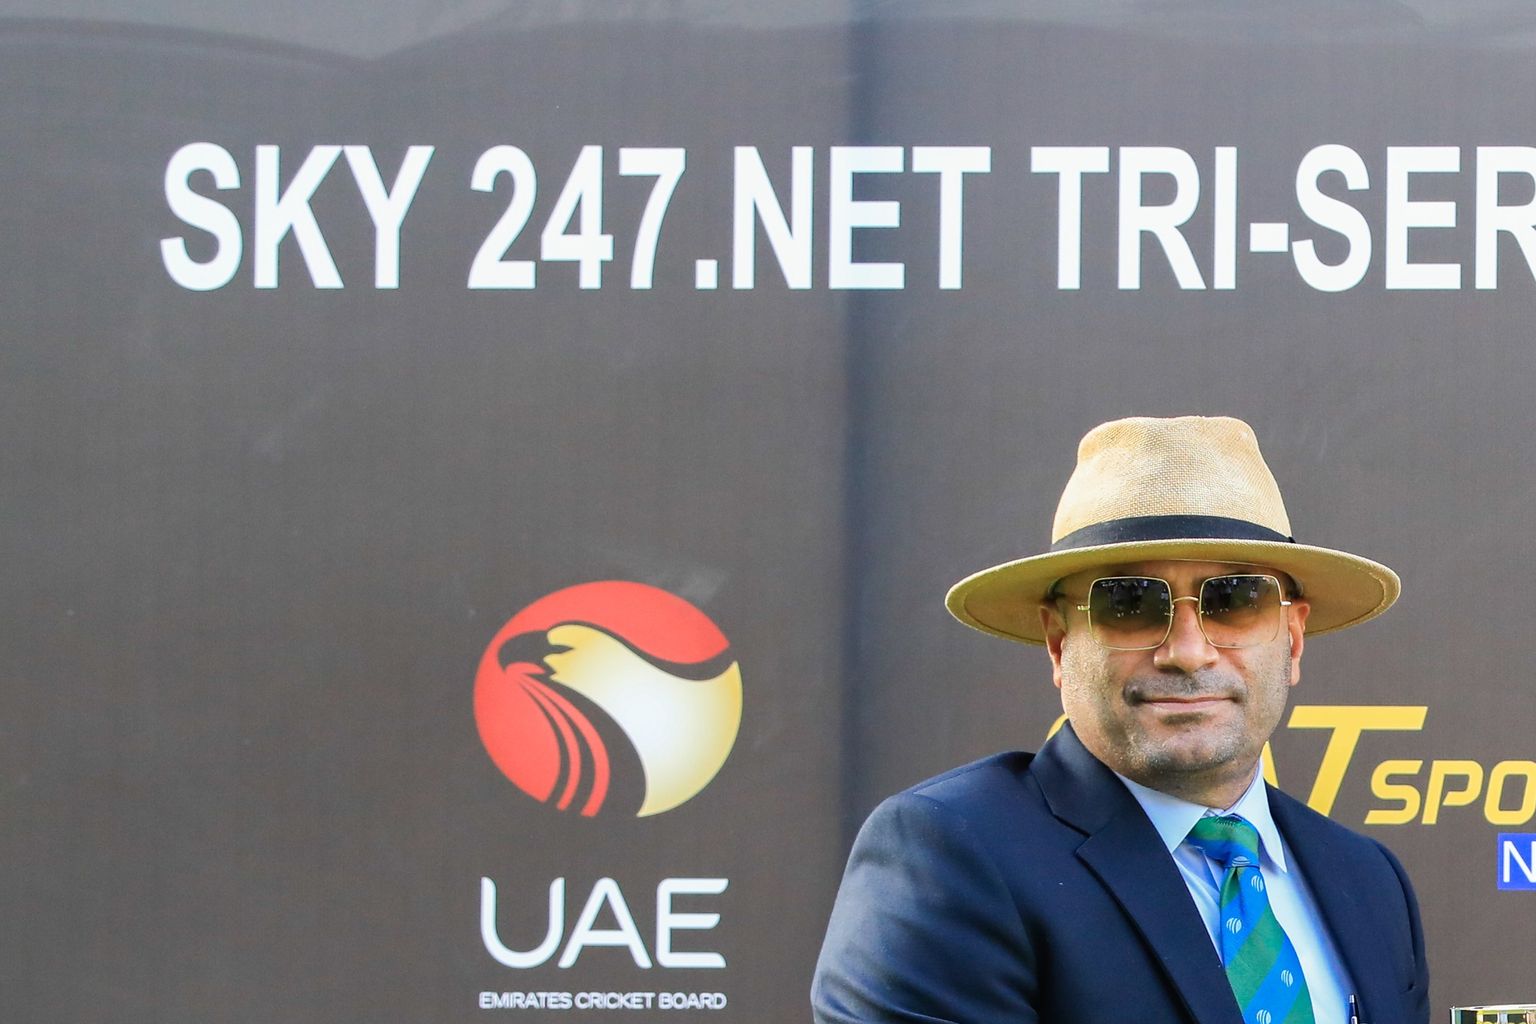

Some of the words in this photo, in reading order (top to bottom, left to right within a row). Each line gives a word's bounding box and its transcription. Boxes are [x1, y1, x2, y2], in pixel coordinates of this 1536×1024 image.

[160, 142, 435, 292] SKY
[468, 145, 992, 291] 247.NET
[481, 877, 729, 969] UAE
[479, 992, 573, 1010] EMIRATES
[575, 992, 656, 1010] CRICKET
[659, 992, 727, 1010] BOARD
